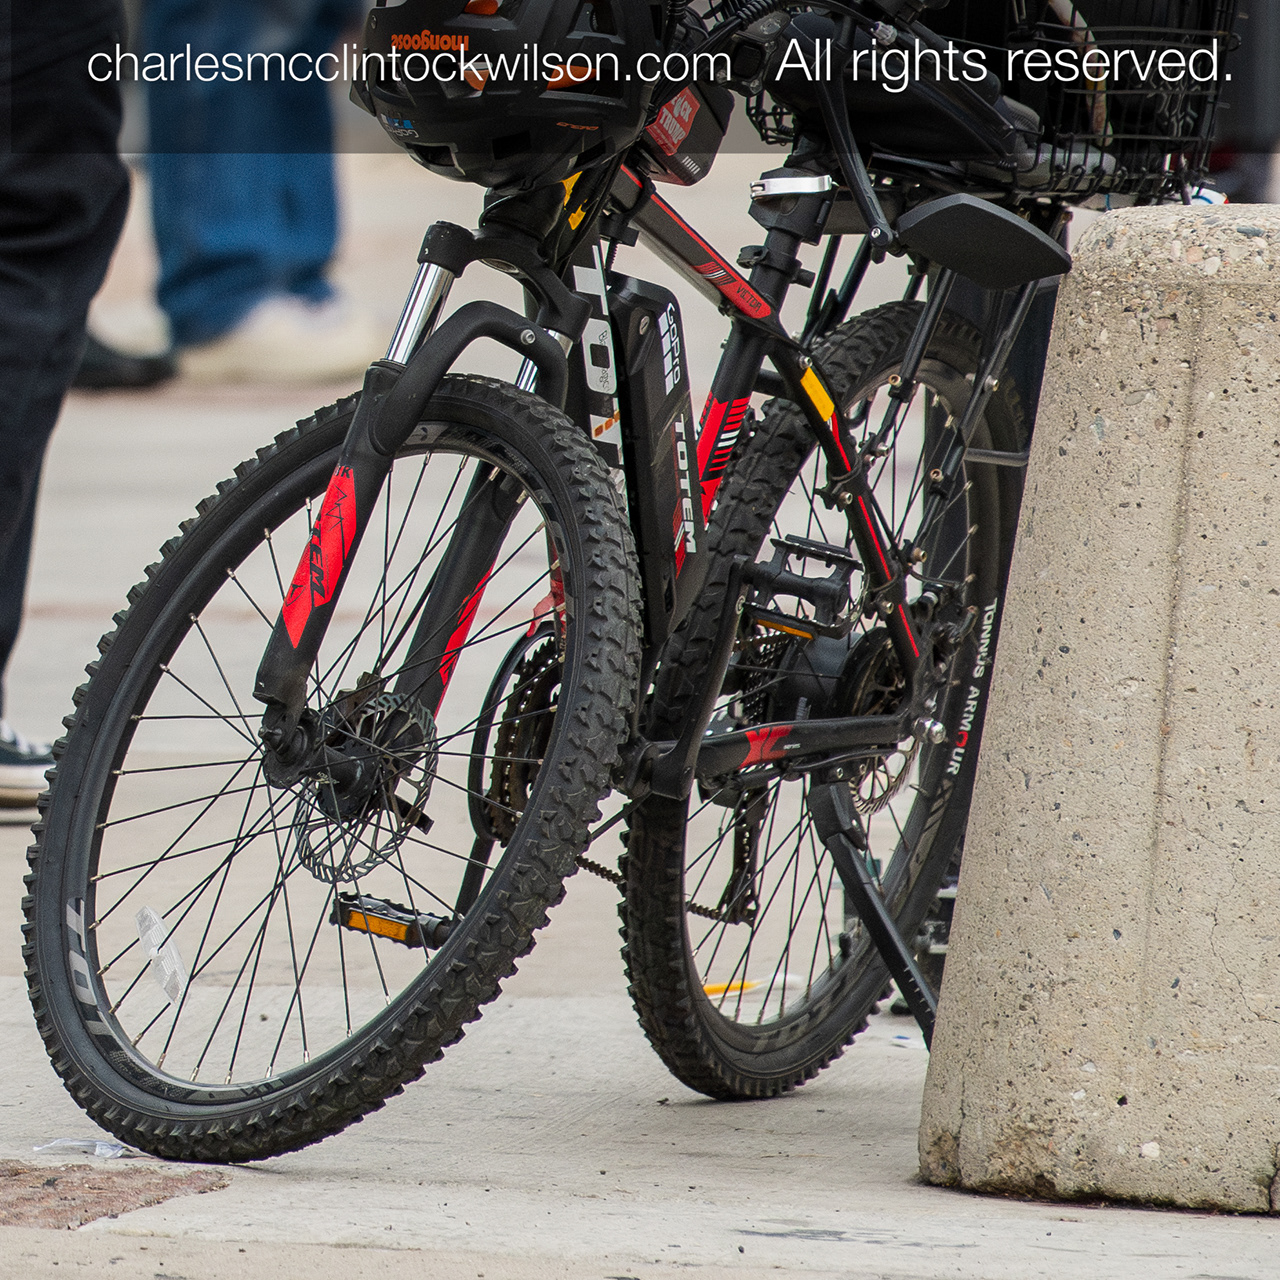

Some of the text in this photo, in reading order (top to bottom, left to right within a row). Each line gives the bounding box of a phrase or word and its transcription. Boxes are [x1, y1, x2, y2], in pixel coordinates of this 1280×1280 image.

[390, 29, 470, 52] mongoose
[659, 106, 687, 145] TRUMP
[666, 302, 682, 387] GoPro
[674, 412, 698, 554] TOTEM
